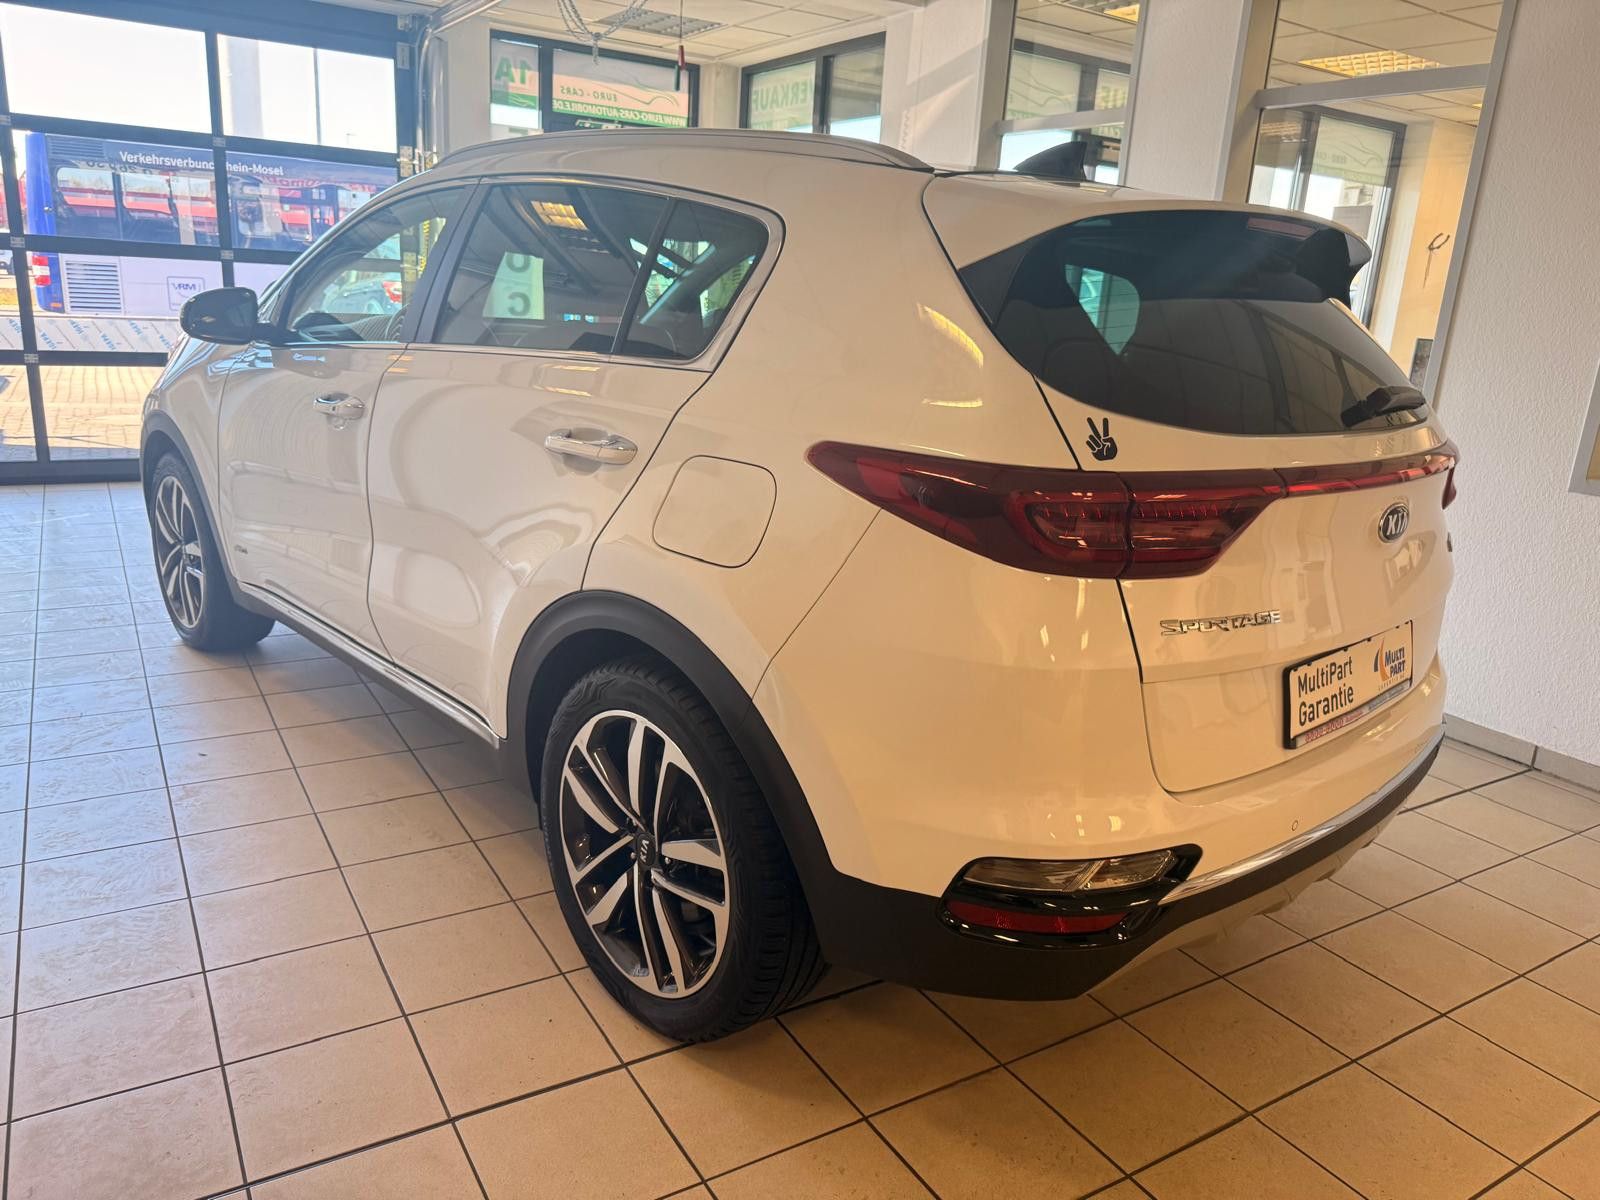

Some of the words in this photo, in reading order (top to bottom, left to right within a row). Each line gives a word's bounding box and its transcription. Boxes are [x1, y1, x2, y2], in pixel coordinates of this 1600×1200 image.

[225, 161, 284, 176] hein-Mosel
[1160, 609, 1281, 636] SPORTAGE
[1297, 656, 1353, 698] MultiPart
[1389, 660, 1406, 678] PART
[1298, 683, 1355, 727] Garantie
